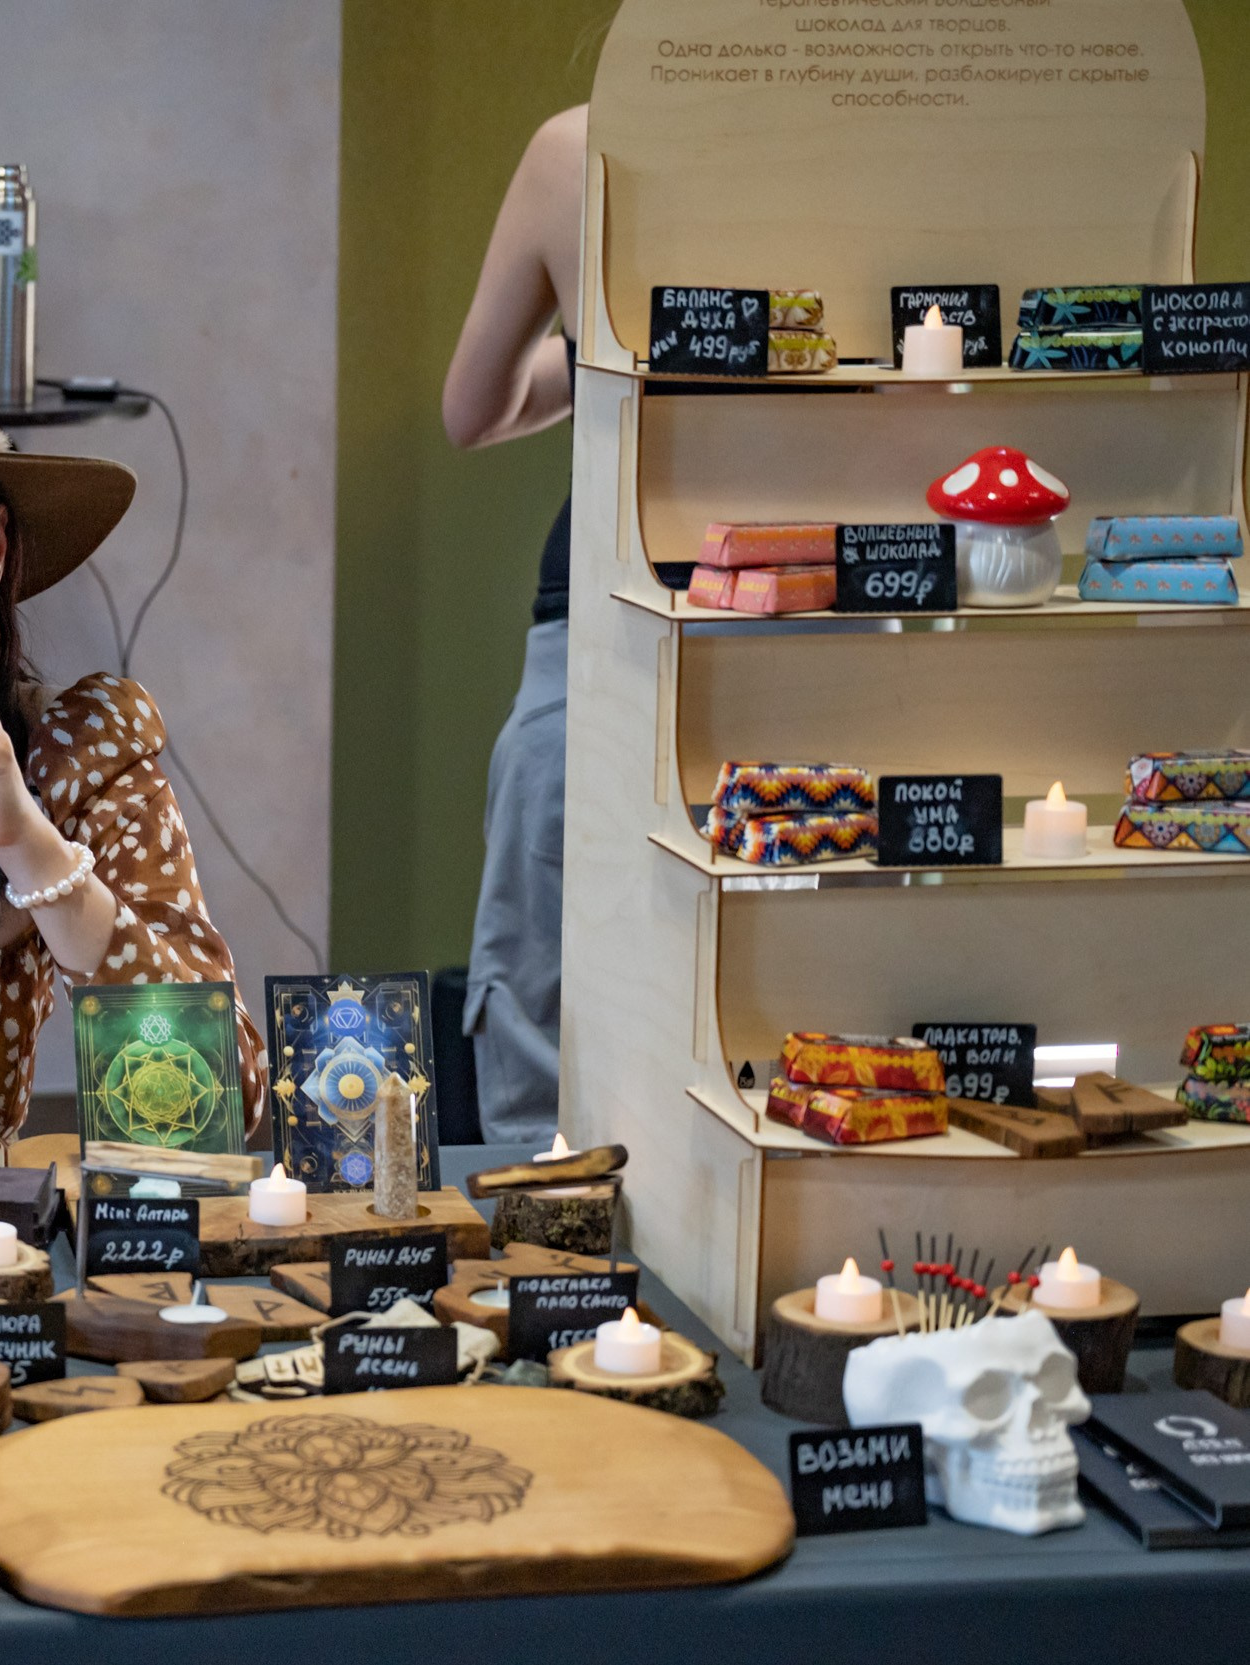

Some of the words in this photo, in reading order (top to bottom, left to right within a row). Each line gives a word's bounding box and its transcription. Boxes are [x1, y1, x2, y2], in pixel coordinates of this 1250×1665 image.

[796, 19, 886, 33] шоколад
[891, 19, 923, 33] для
[929, 19, 1011, 35] творцов.
[658, 40, 712, 58] Одна
[718, 43, 787, 58] долька
[805, 43, 934, 58] возможность
[940, 43, 1014, 60] открыть
[1019, 43, 1075, 58] что-то
[1081, 43, 1144, 58] новое.
[650, 65, 759, 84] Проникает
[765, 69, 774, 82] в
[779, 65, 855, 84] глубину
[861, 69, 918, 84] души,
[925, 65, 1063, 84] разблокирует
[1069, 69, 1150, 84] скрытые
[832, 89, 970, 107] способности.
[662, 288, 733, 310] БАЛАНС
[1151, 290, 1244, 313] ШОКОЛАД
[681, 309, 736, 330] ДУХА
[1168, 314, 1250, 336] экстракто
[689, 334, 728, 360] 499
[843, 525, 941, 544] ВОЛШЕБНЫЙ
[865, 541, 942, 561] ШОКОЛАД
[894, 778, 963, 803] ПОКОЙ
[913, 804, 959, 825] УМА
[95, 1202, 130, 1220] Mini
[344, 1247, 395, 1268] РУНЫ
[395, 1246, 436, 1267] ДУБ
[338, 1332, 406, 1355] РУНЫ
[796, 1434, 912, 1475] ВОЗЬМИ
